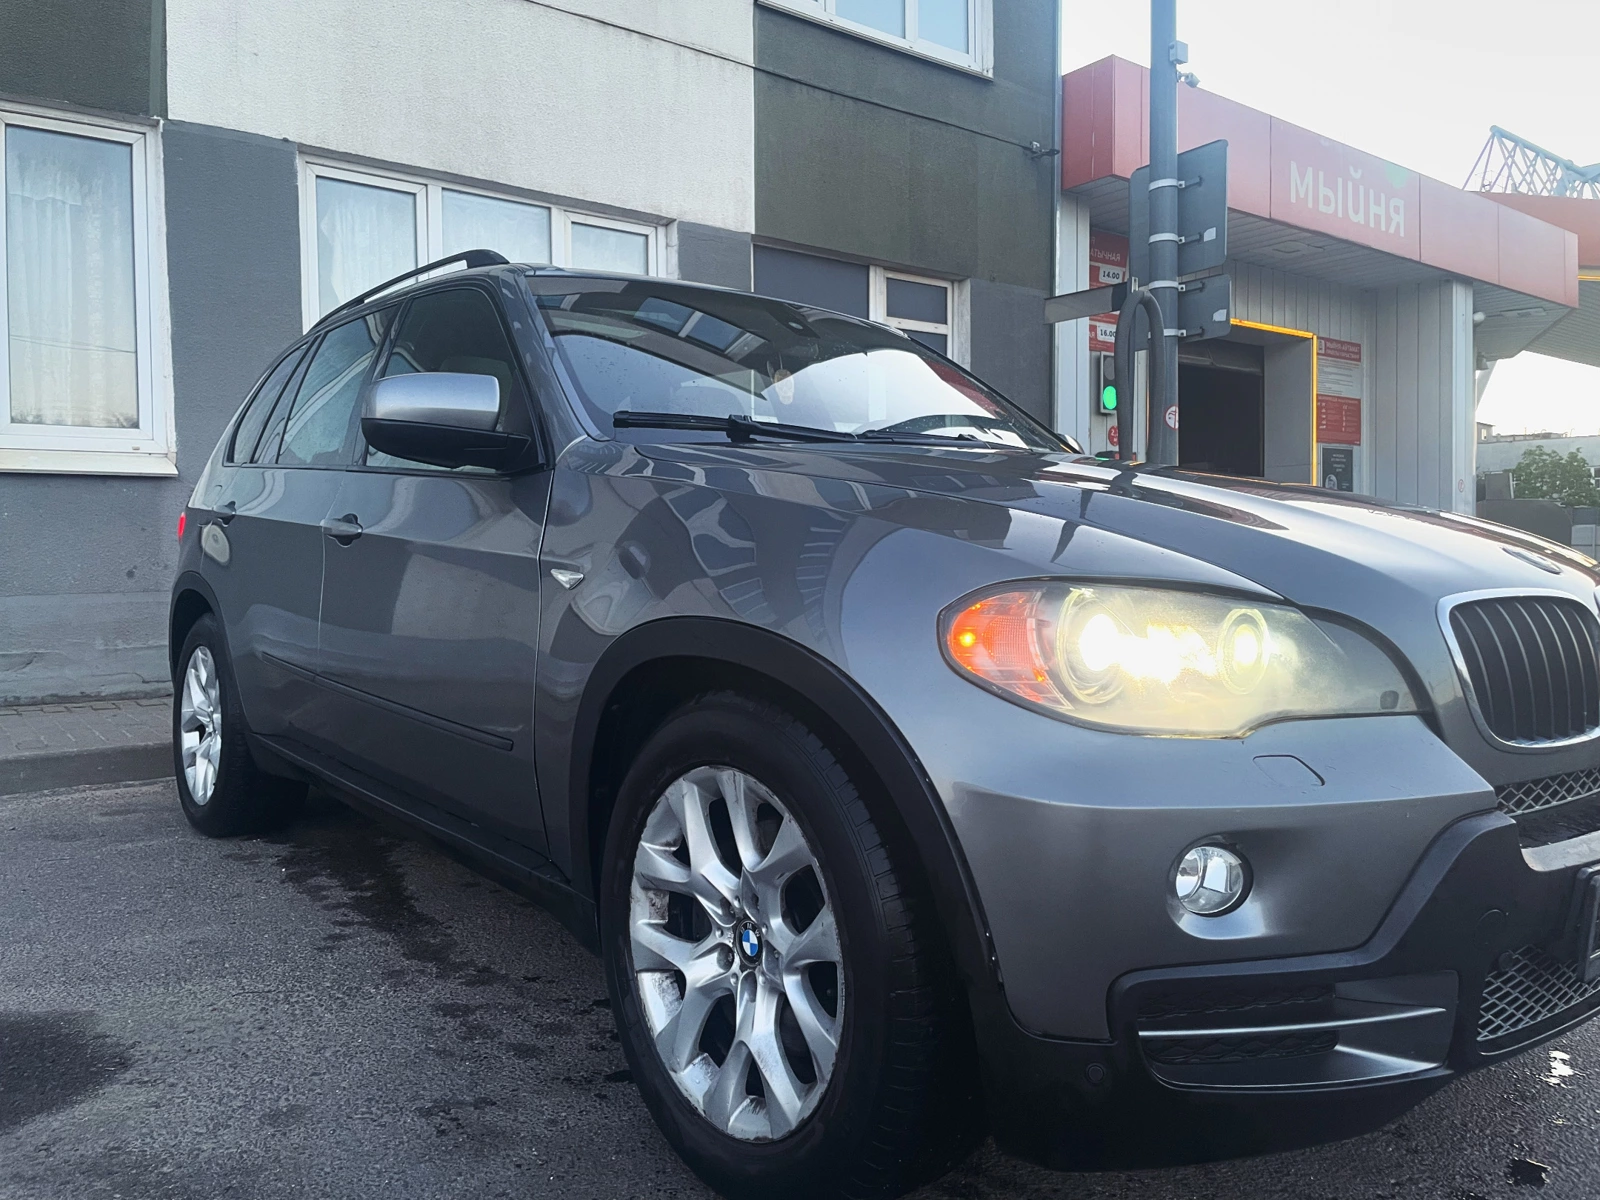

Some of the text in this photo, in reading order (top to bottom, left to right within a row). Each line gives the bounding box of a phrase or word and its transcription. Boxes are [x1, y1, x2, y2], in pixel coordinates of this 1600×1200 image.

[1290, 160, 1405, 237] МЫЙНЯ
[1102, 270, 1120, 280] 14.00
[740, 922, 761, 937] BMW
